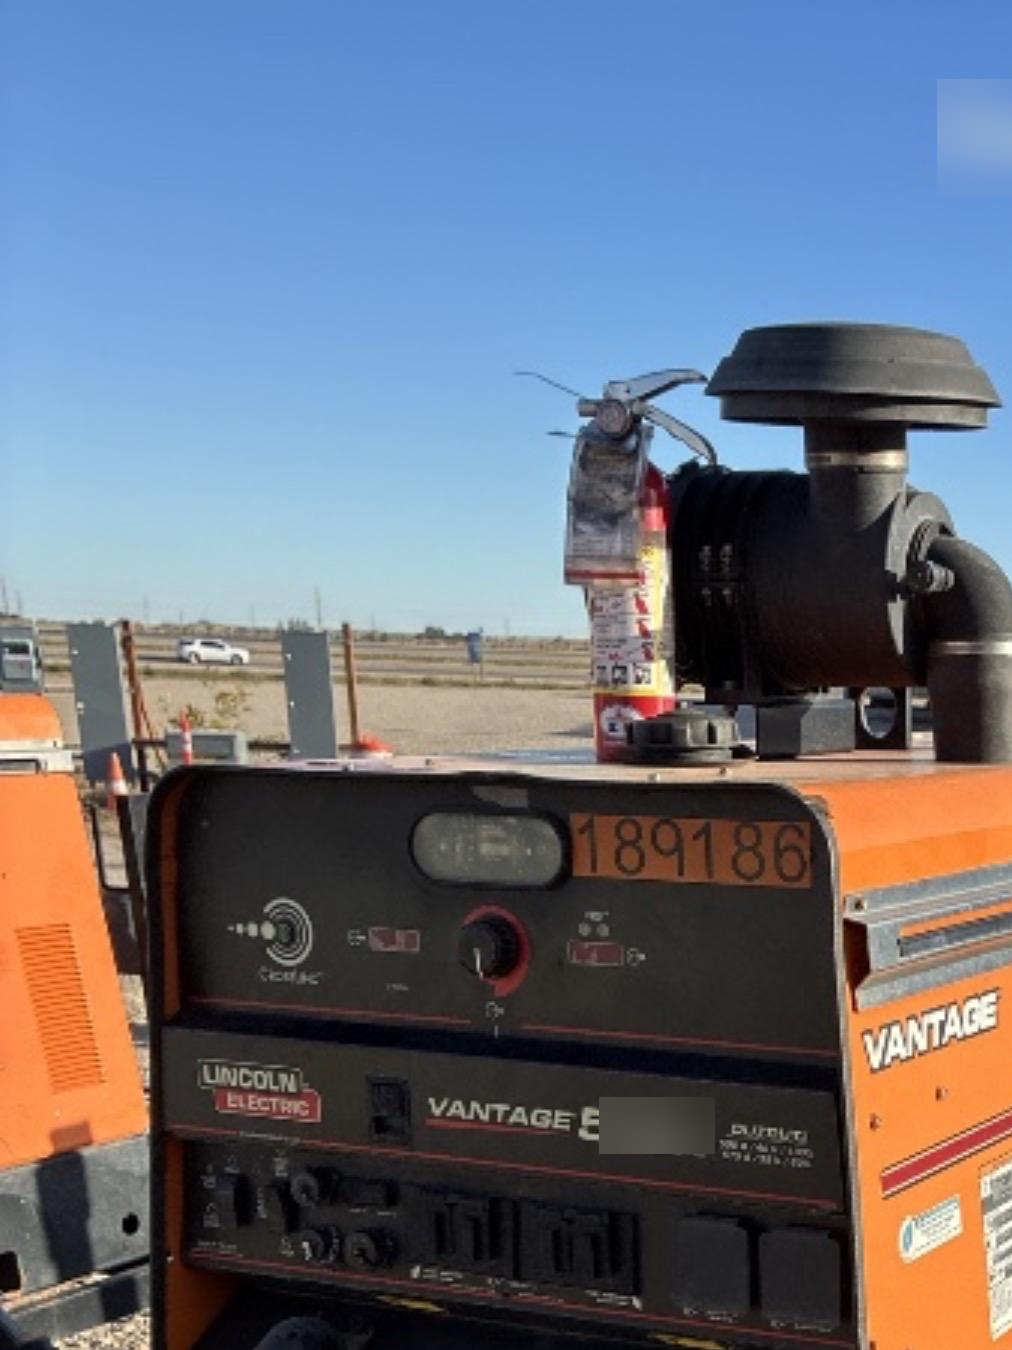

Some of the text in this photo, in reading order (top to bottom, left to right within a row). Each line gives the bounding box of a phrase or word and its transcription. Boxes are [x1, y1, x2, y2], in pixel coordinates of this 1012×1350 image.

[577, 815, 808, 883] 189186
[862, 988, 999, 1072] VANTAGE
[202, 1063, 298, 1094] LINCOLN
[226, 1091, 310, 1118] ELECTRIC
[427, 1096, 577, 1132] VANTAGE
